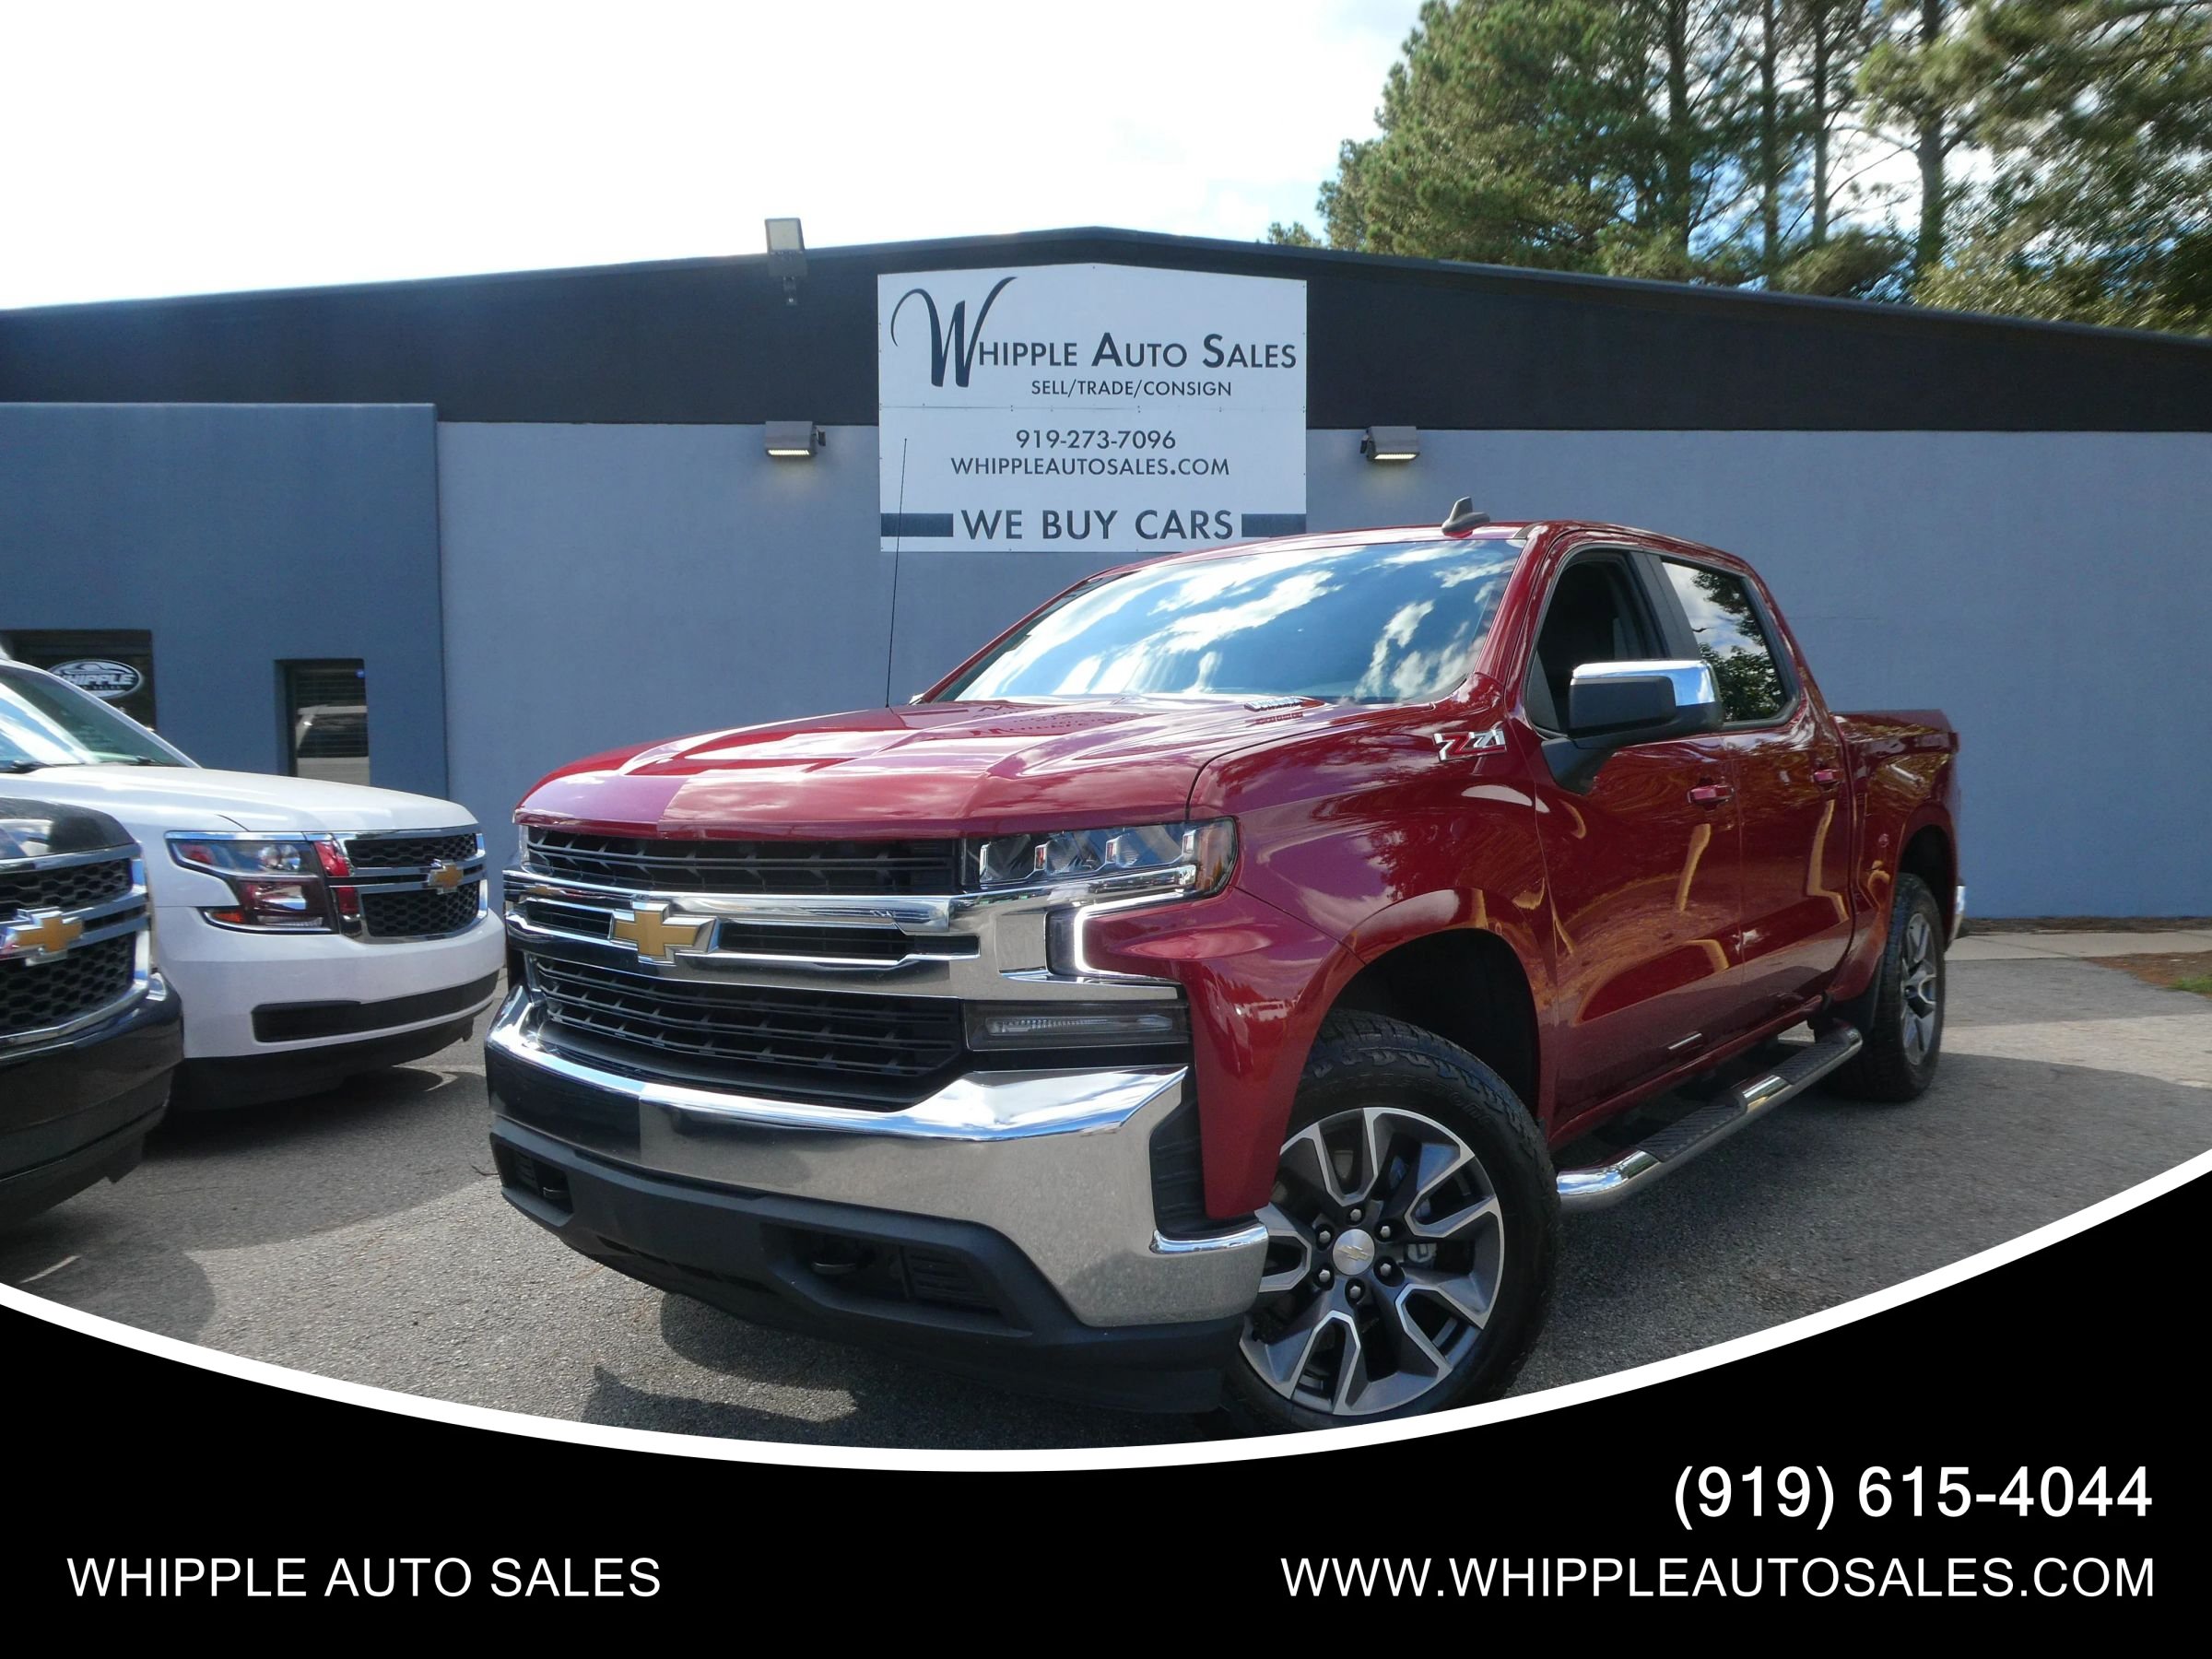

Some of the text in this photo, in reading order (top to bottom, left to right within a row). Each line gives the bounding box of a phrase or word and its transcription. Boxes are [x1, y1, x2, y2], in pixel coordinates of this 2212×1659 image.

[1031, 379, 1232, 398] SELL/TRADE/CONSIGN
[1016, 429, 1177, 450] 919-273-7096
[950, 457, 1230, 477] WHIPPLEAUTOSALES.COM
[961, 509, 1233, 540] WE BUY CARS
